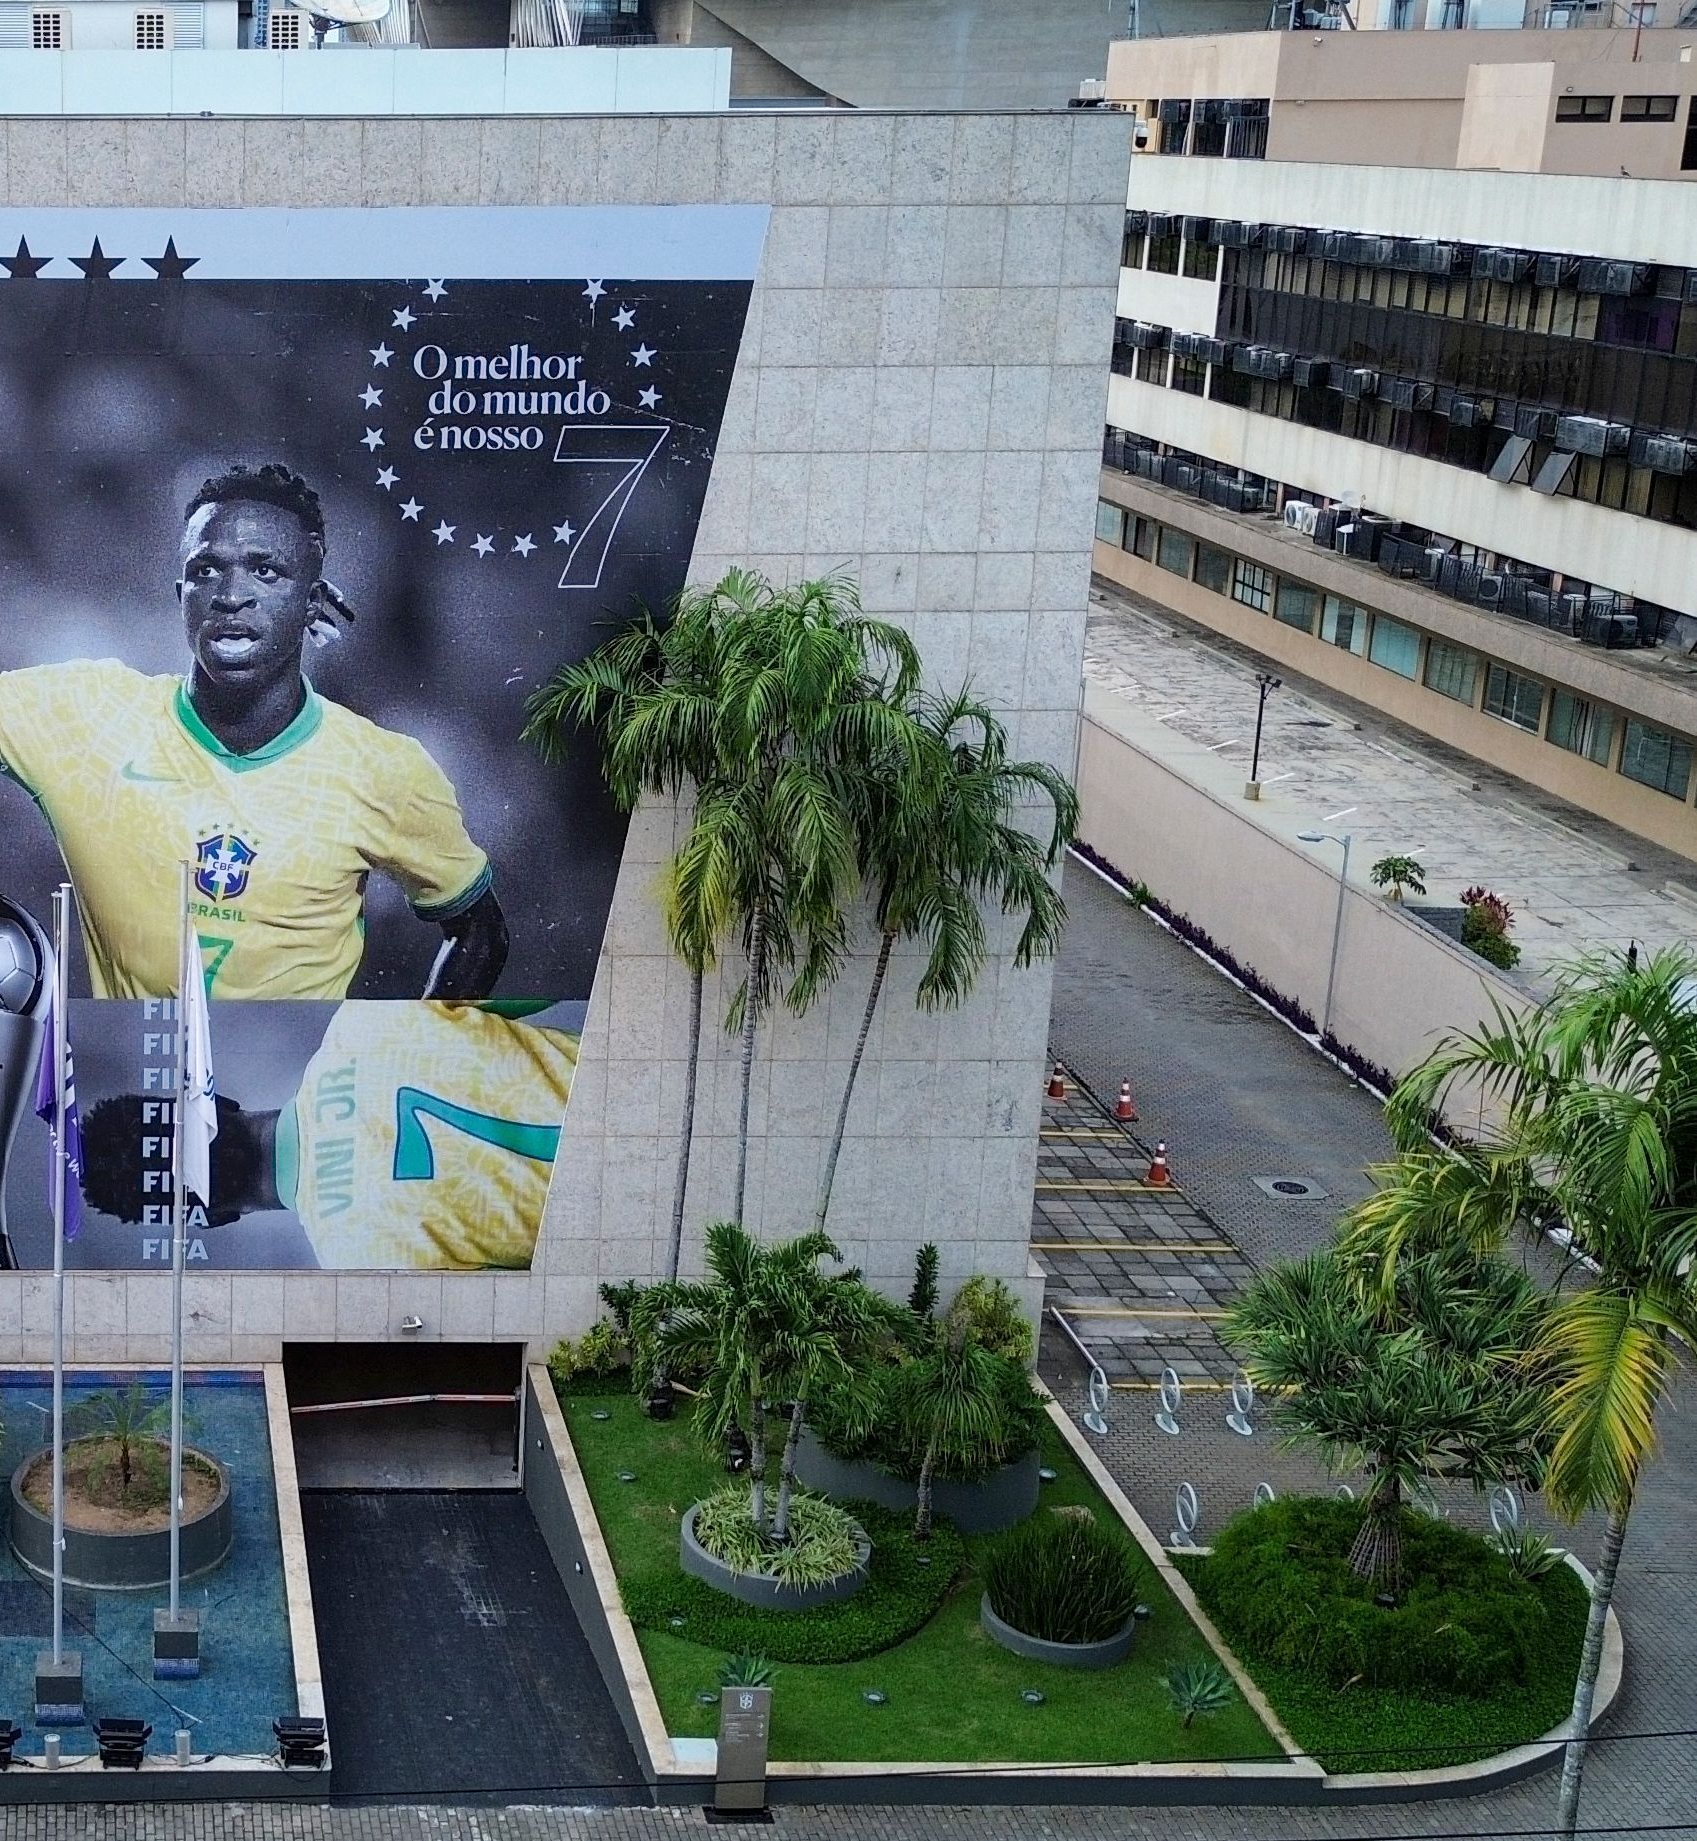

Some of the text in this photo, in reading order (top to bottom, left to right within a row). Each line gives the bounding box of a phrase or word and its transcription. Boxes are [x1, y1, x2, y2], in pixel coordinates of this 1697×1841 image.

[413, 343, 582, 380] O melhor
[428, 379, 611, 415] do mundo
[414, 418, 544, 450] é nosso
[553, 425, 670, 588] 7
[212, 861, 234, 872] CBF
[188, 902, 246, 922] BRASIL
[315, 1057, 357, 1219] VINI JR.
